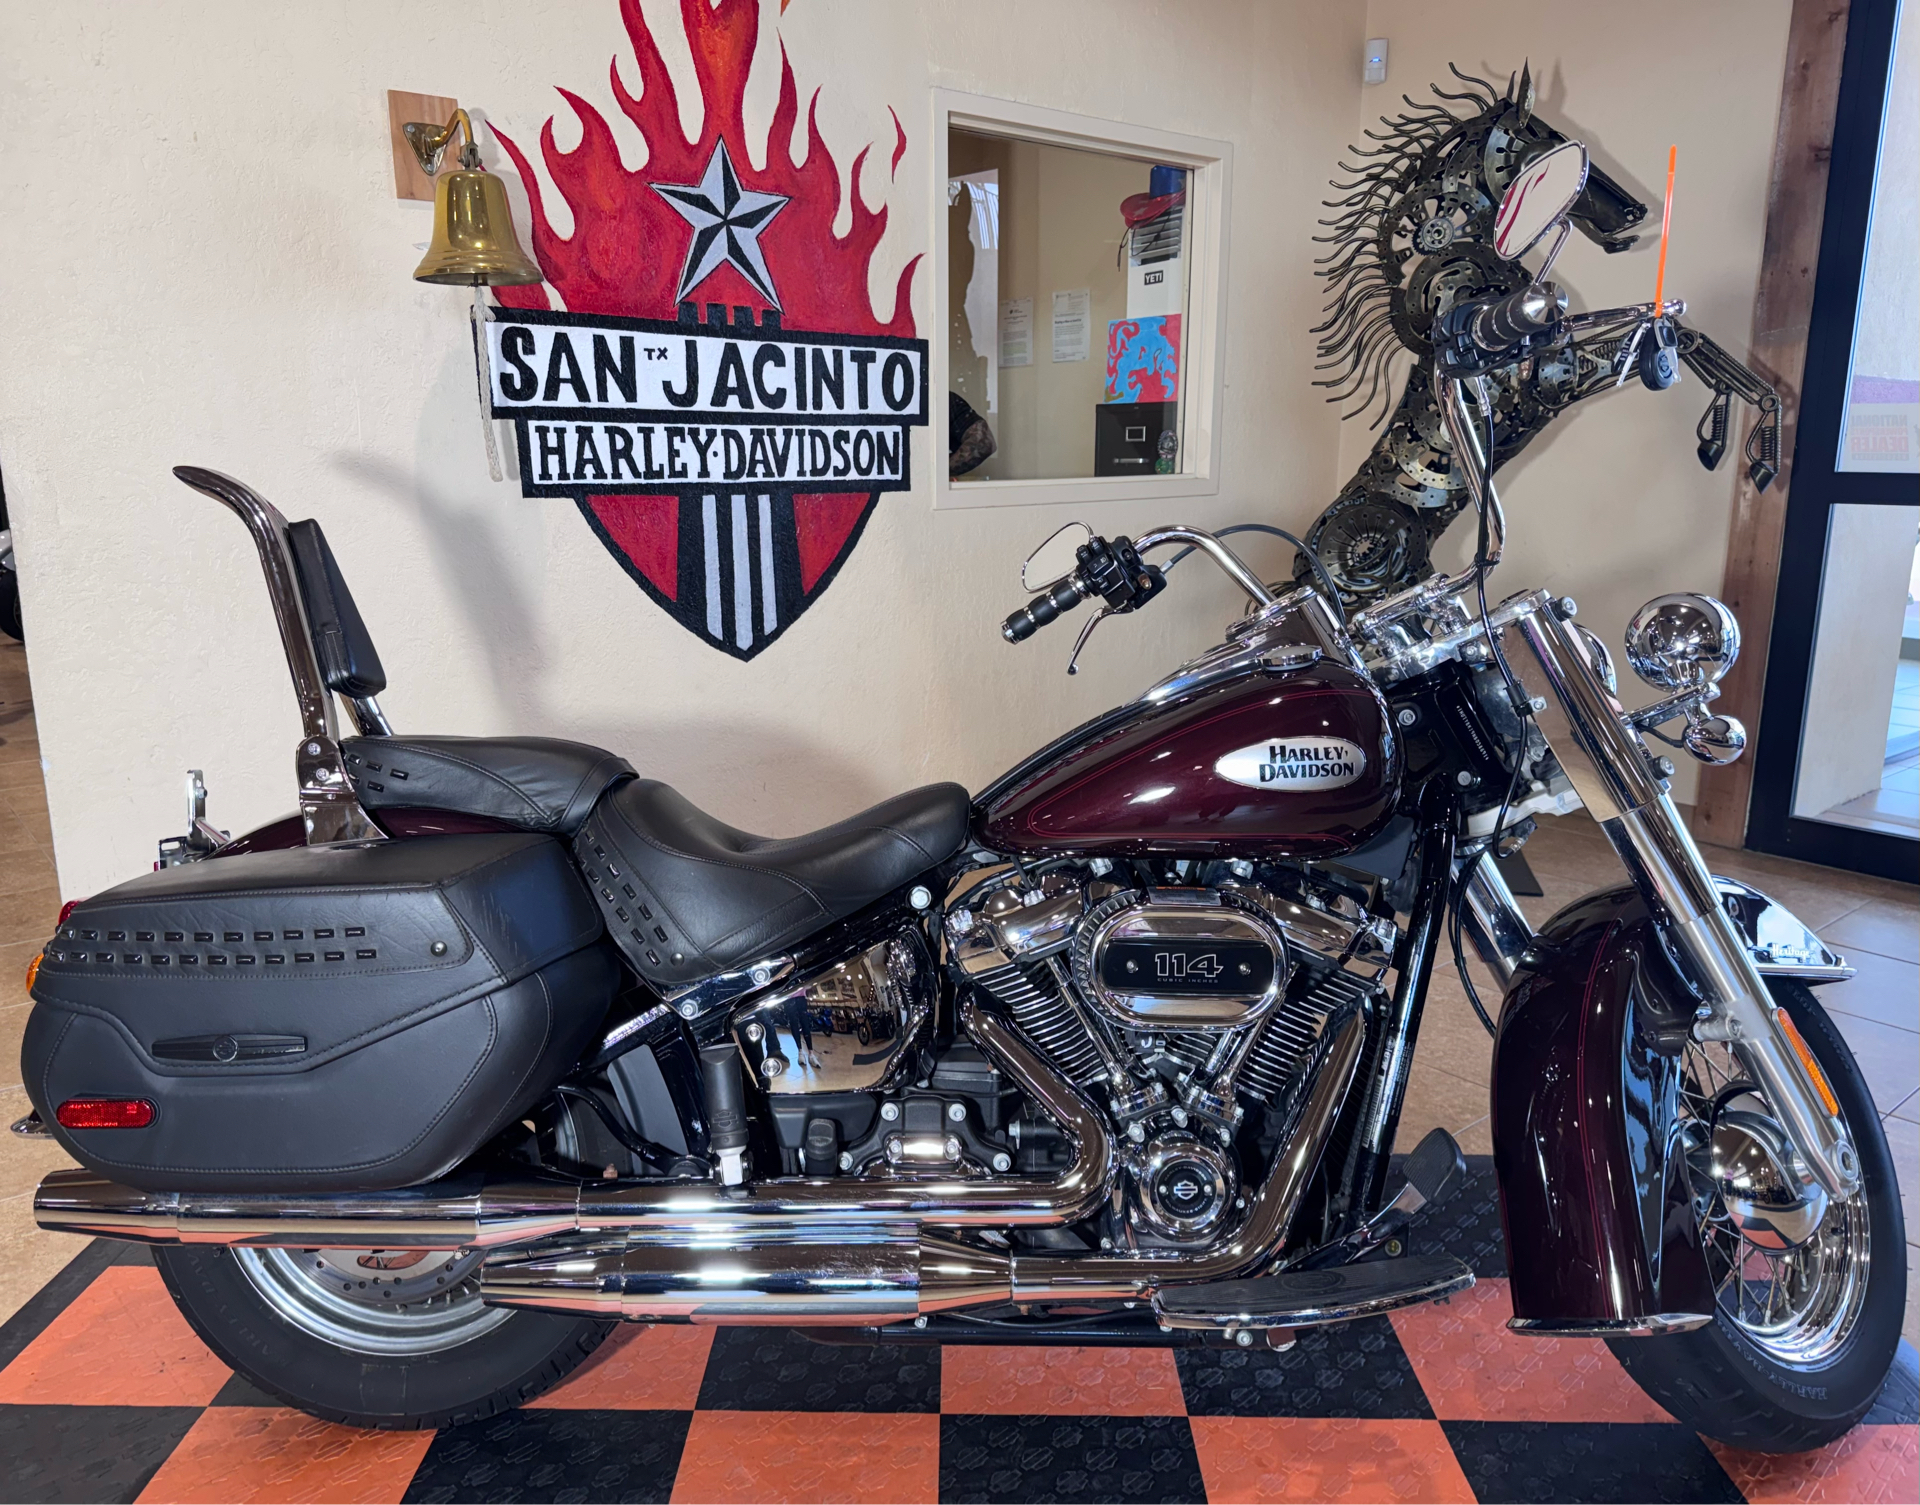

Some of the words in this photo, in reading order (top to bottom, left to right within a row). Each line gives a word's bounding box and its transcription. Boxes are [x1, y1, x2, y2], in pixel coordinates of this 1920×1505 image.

[1145, 272, 1162, 284] YETI
[500, 325, 636, 403] SAN
[644, 347, 668, 361] TX
[663, 339, 915, 411] JACINTO
[1259, 763, 1354, 782] DAVIDSON
[1154, 952, 1224, 978] 114
